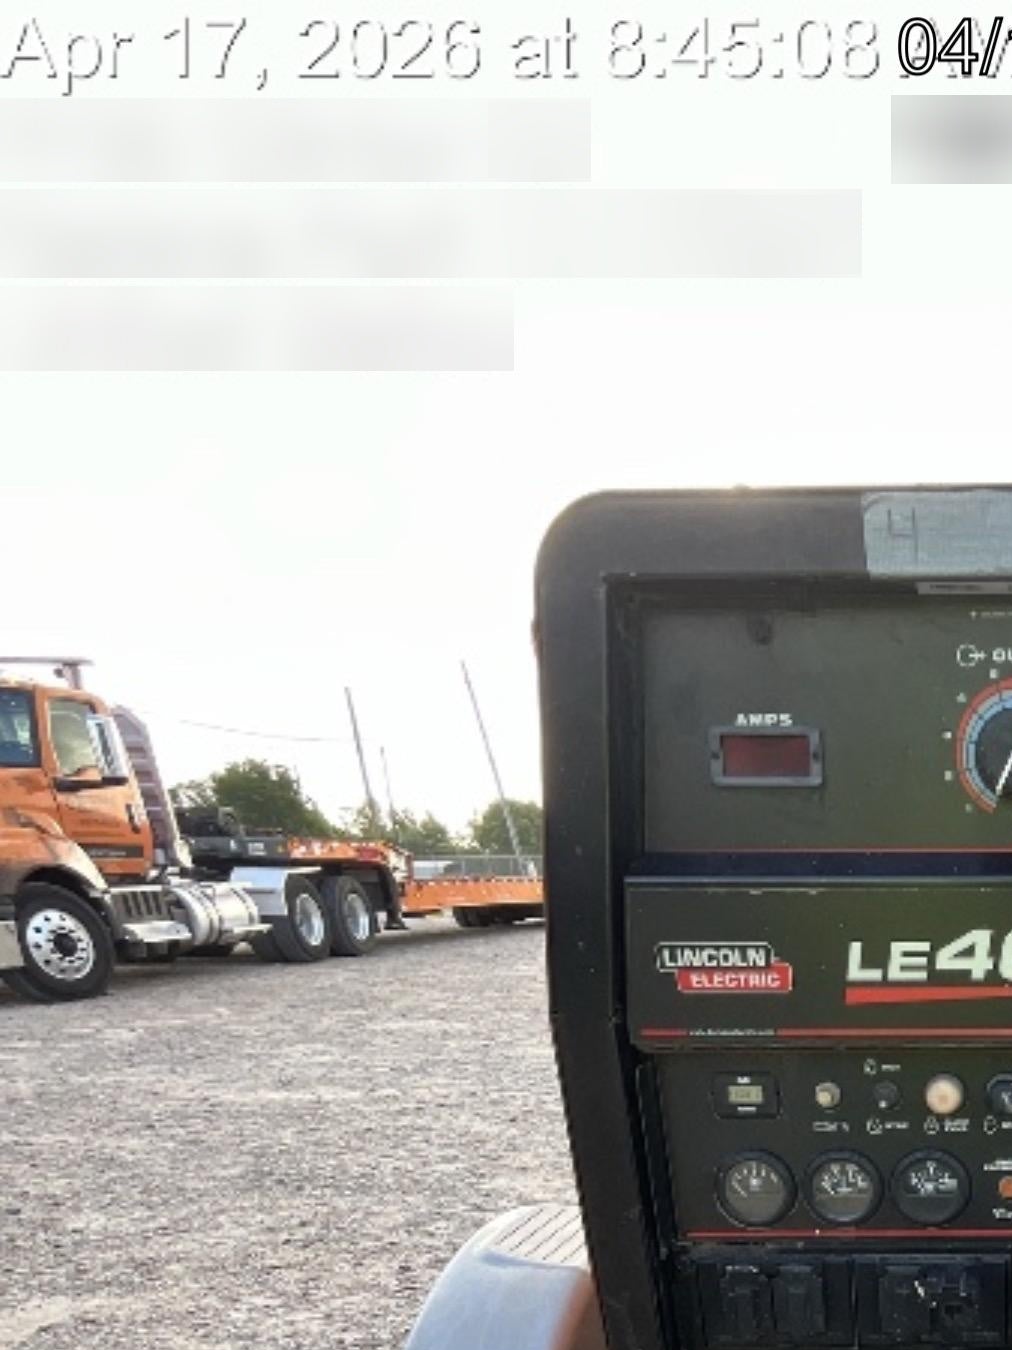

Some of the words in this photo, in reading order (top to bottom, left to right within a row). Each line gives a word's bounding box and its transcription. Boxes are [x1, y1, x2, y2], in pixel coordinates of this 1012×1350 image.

[734, 712, 794, 728] AMPS
[661, 946, 767, 968] LINCOLN
[689, 970, 782, 989] ELECTRIC
